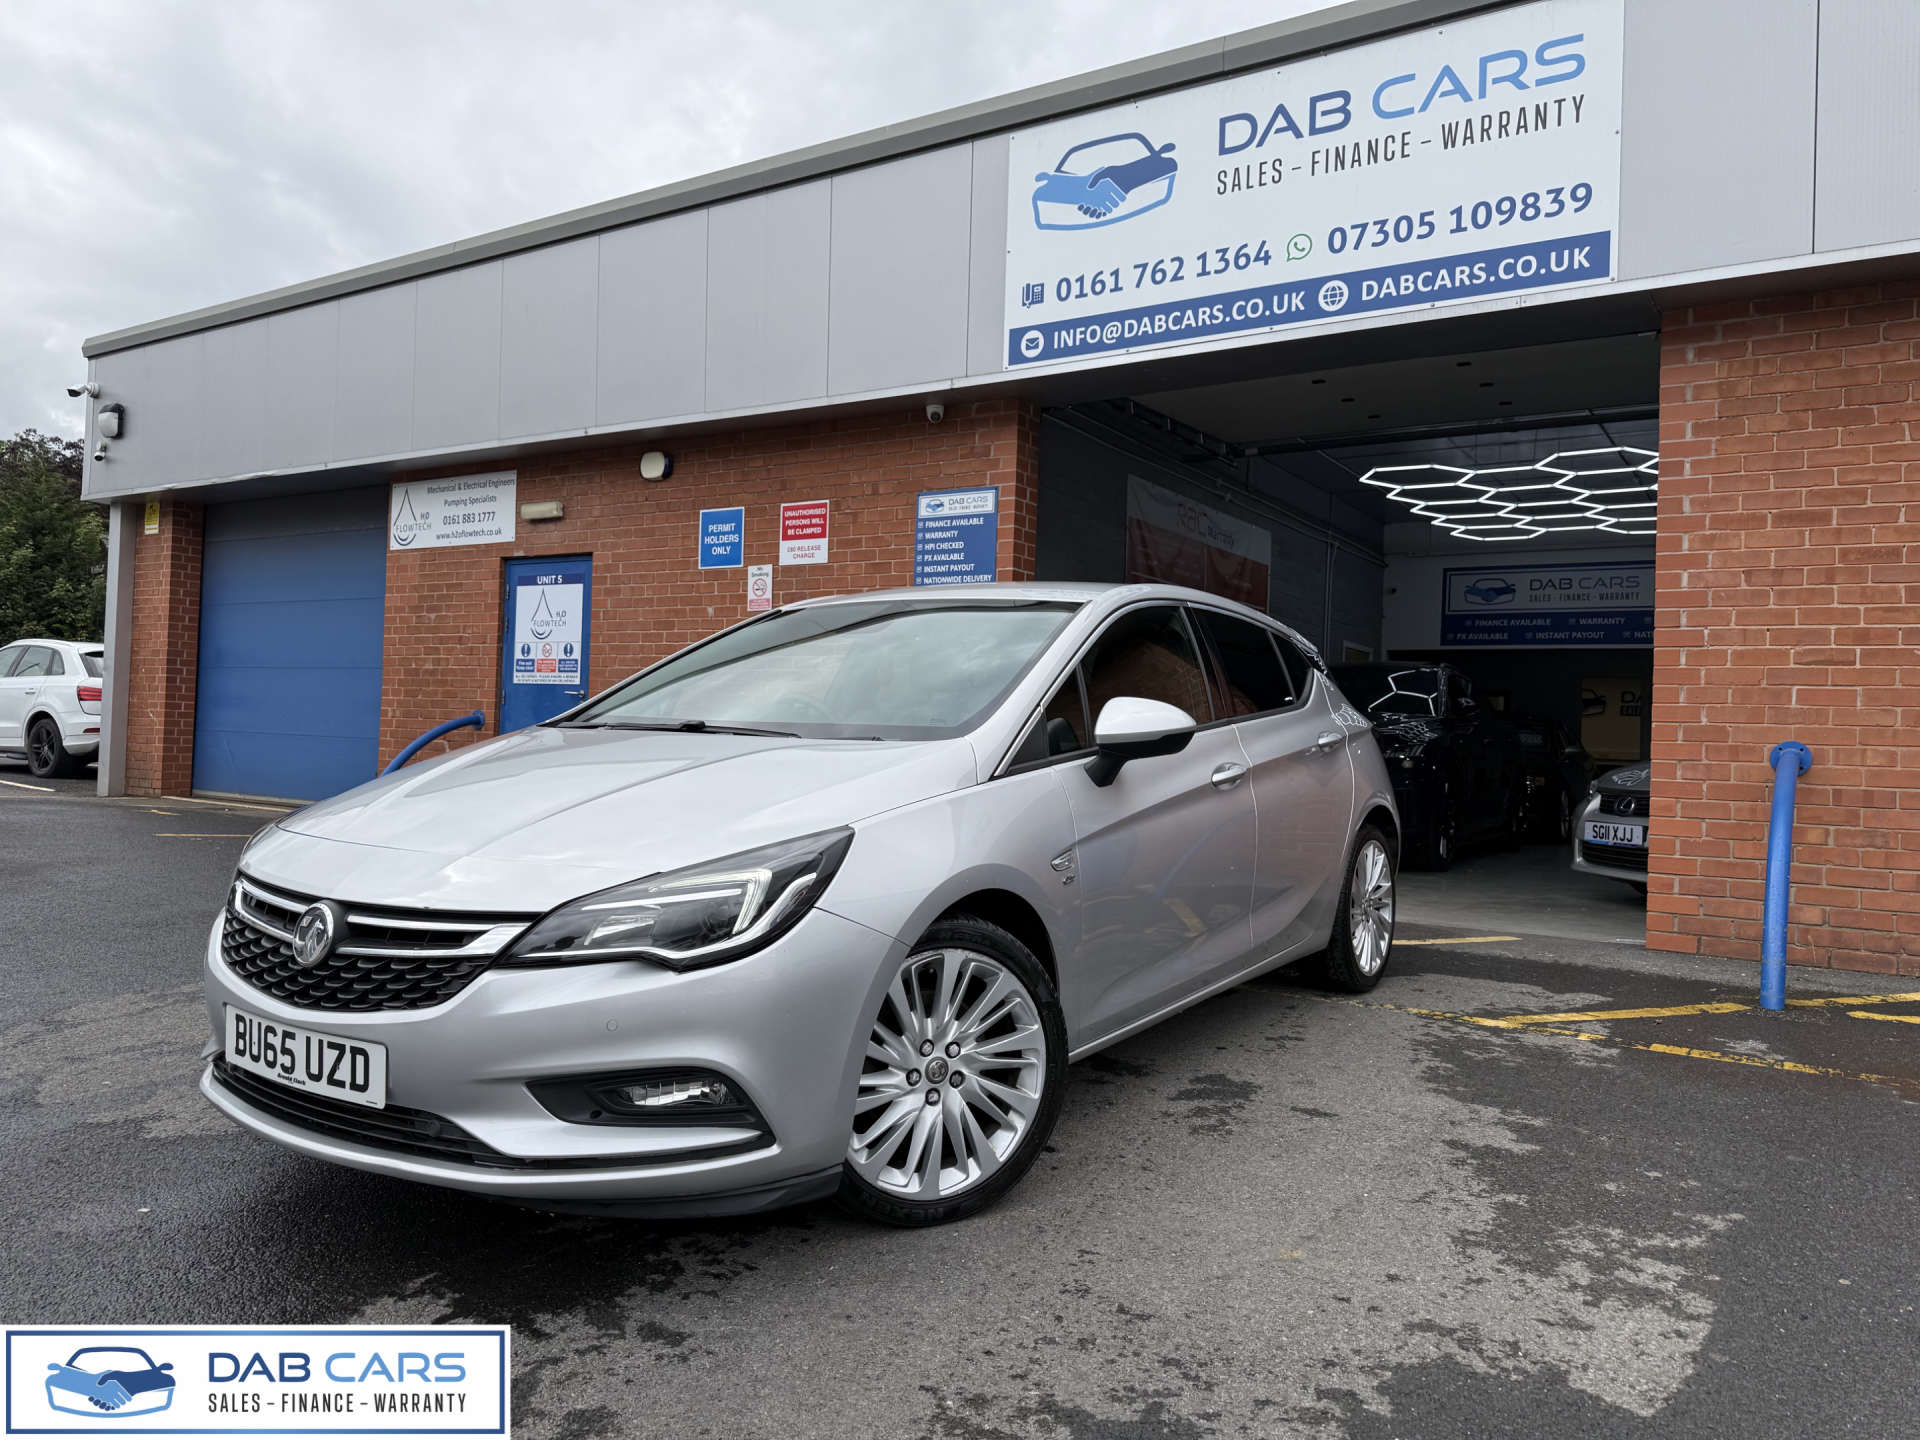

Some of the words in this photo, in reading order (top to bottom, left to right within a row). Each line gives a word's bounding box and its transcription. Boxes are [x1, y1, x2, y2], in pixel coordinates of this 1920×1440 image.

[1218, 89, 1352, 156] DAB
[1371, 33, 1586, 120] CARS
[1216, 158, 1283, 195] SALES
[1311, 131, 1412, 176] FINANCE
[1441, 94, 1585, 150] WARRANTY
[1327, 210, 1436, 254] 07305
[1449, 182, 1593, 234] 109839
[1056, 267, 1124, 302] 0161
[1133, 256, 1185, 289] 762
[1195, 239, 1272, 278] 1364
[1361, 246, 1591, 301] DABCARS.CO.UK
[1053, 291, 1305, 349] INFO@DABCARS.CO.UK
[784, 508, 826, 517] UNAUTHORISED
[442, 514, 460, 526] 0161
[462, 512, 476, 524] 883
[477, 511, 496, 523] 1777
[786, 518, 810, 527] PERSONS
[925, 519, 951, 528] FINANCE
[952, 517, 984, 526] AVAILABLE
[708, 523, 736, 533] PERMIT
[795, 527, 822, 535] CLAMPED
[704, 534, 739, 544] HOLDERS
[925, 530, 958, 539] WARRANTY
[712, 545, 731, 555] ONLY
[924, 543, 935, 551] HPI
[936, 542, 965, 550] CHECKED
[933, 553, 965, 561] AVAILABLE
[924, 564, 949, 573] INSTANT
[537, 575, 556, 584] UNIT
[557, 575, 563, 583] 5
[923, 575, 962, 584] NATIONWIDE
[963, 574, 992, 582] DELIVERY
[1529, 578, 1573, 591] DAB
[1578, 576, 1640, 589] CARS
[1474, 619, 1508, 627] FINANCE
[1510, 618, 1551, 626] AVAILABLE
[1579, 617, 1625, 625] WARRANTY
[1535, 632, 1570, 640] INSTANT
[1572, 631, 1605, 639] PAYOUT
[1612, 826, 1634, 842] XJJ
[234, 1013, 296, 1075] BU65
[306, 1036, 370, 1093] UZD
